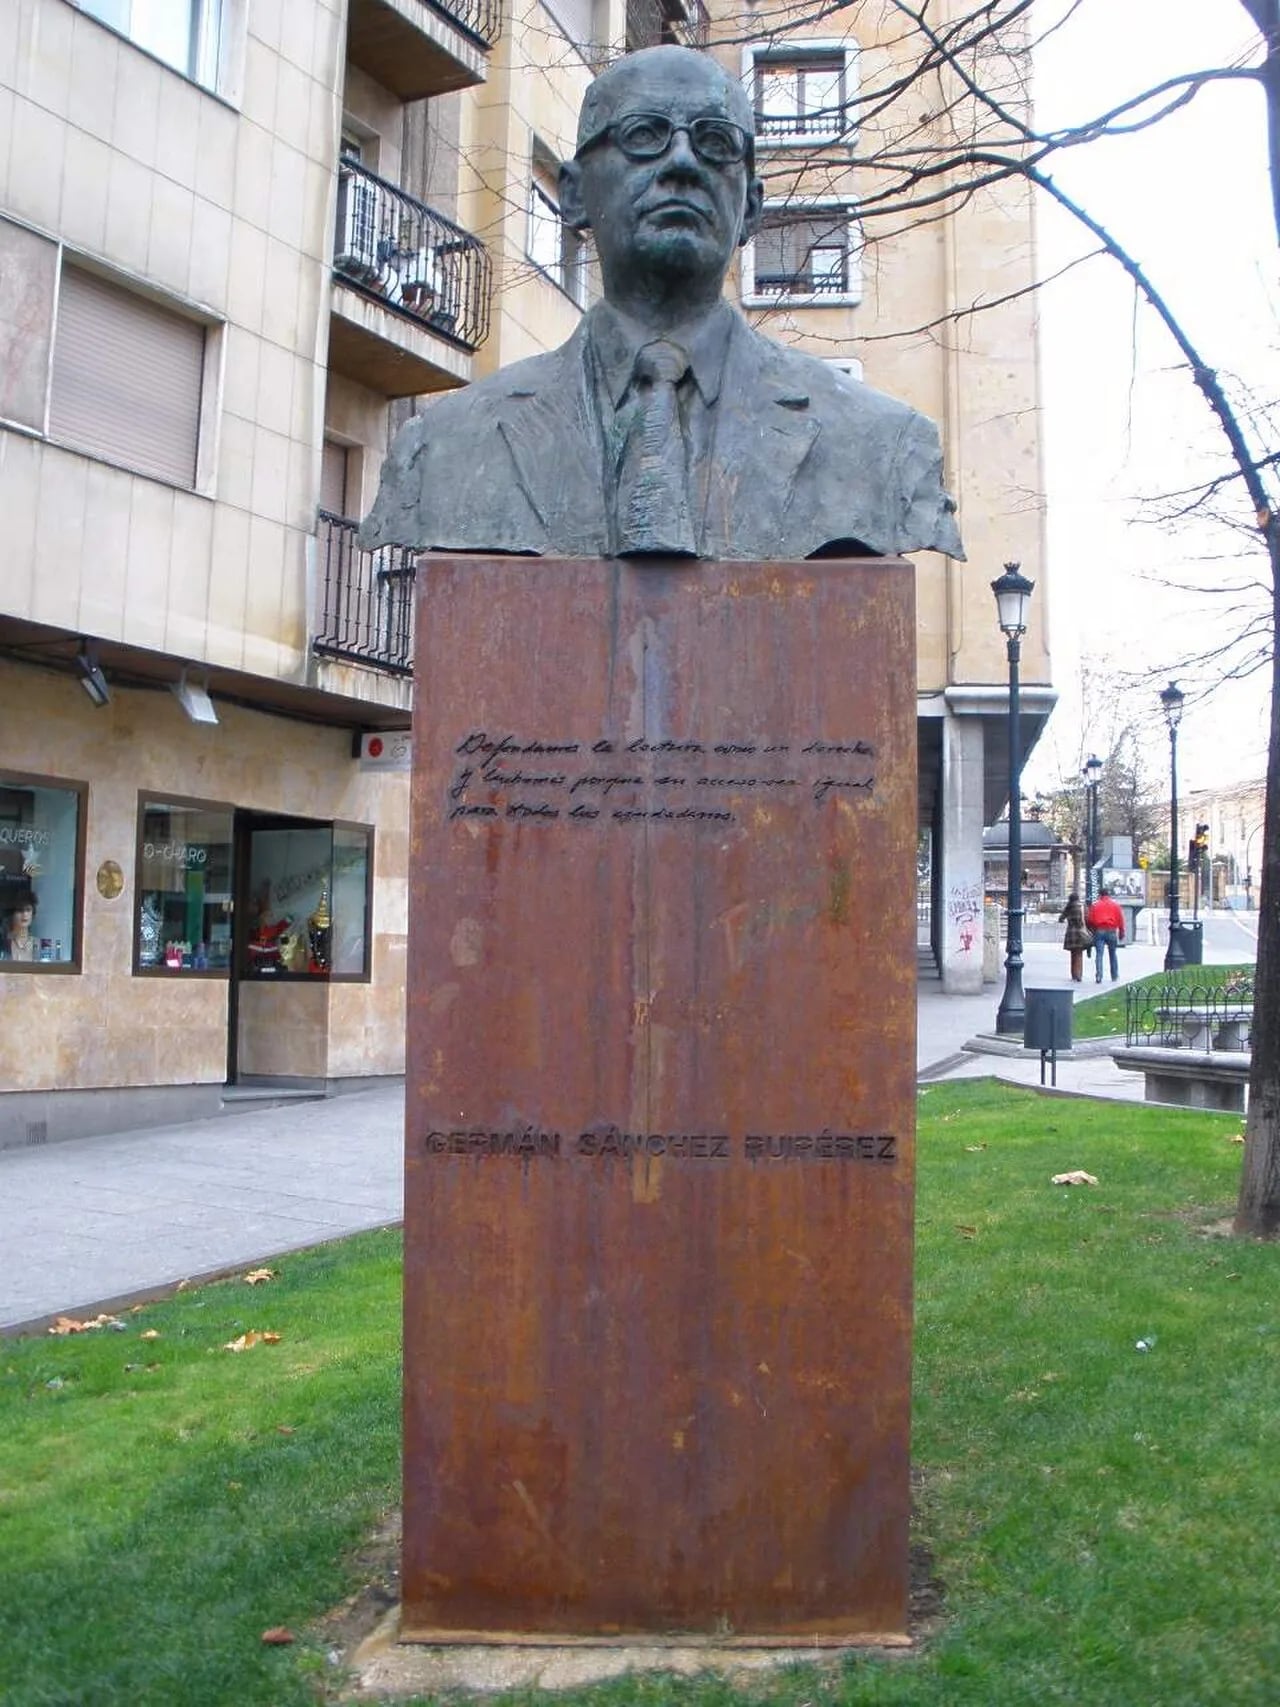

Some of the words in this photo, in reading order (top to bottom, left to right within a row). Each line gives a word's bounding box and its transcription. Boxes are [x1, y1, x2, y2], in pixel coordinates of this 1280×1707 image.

[426, 1126, 561, 1156] GERMÁN
[577, 1126, 730, 1158] SÁNCHEZ
[744, 1128, 896, 1159] RUIPÉREZ
